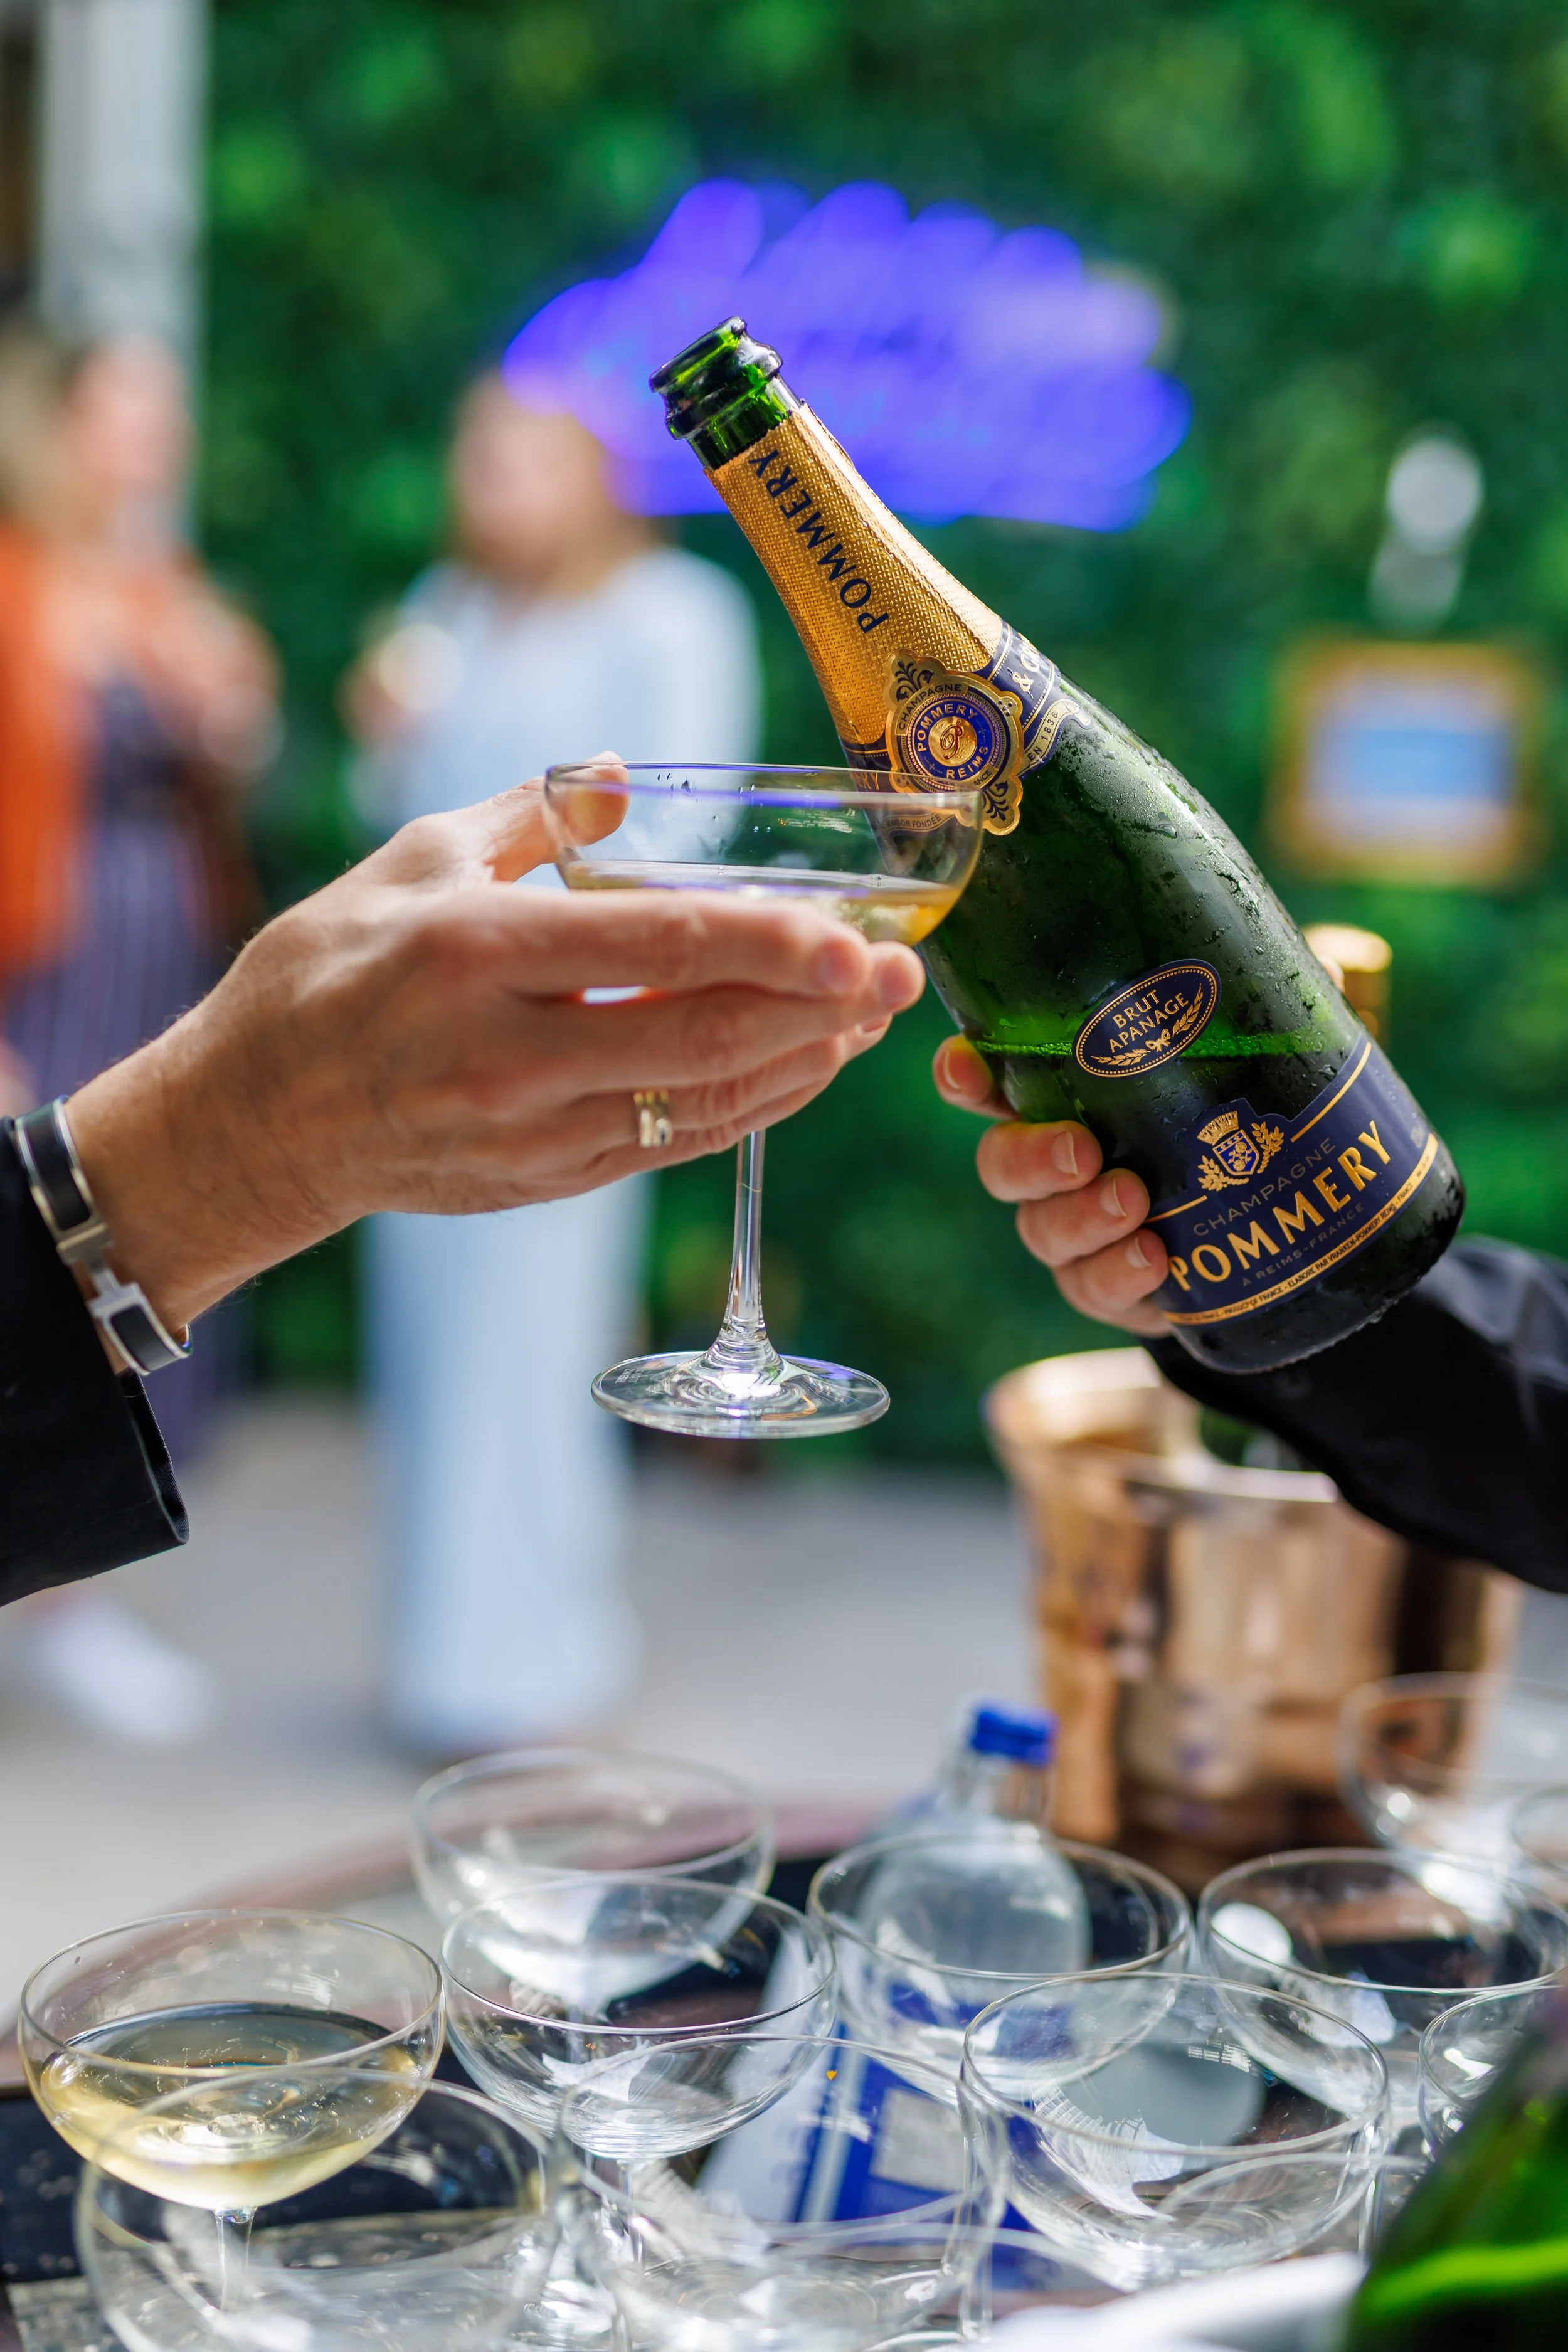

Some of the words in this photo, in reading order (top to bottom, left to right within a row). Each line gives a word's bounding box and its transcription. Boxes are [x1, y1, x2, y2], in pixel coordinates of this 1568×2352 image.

[748, 450, 890, 633] POMMERY
[898, 684, 963, 731] CHAMPAGNE
[916, 703, 978, 752] POMMERY
[1027, 746, 1042, 761] EN
[1041, 712, 1058, 741] 1836
[946, 746, 989, 780] REIMS
[1109, 993, 1189, 1053] APANAGE
[1113, 989, 1160, 1029] BRUT
[1168, 1120, 1391, 1292] POMMERY
[1193, 1138, 1335, 1237] CHAMPAGNE
[1315, 1258, 1330, 1271] PAR
